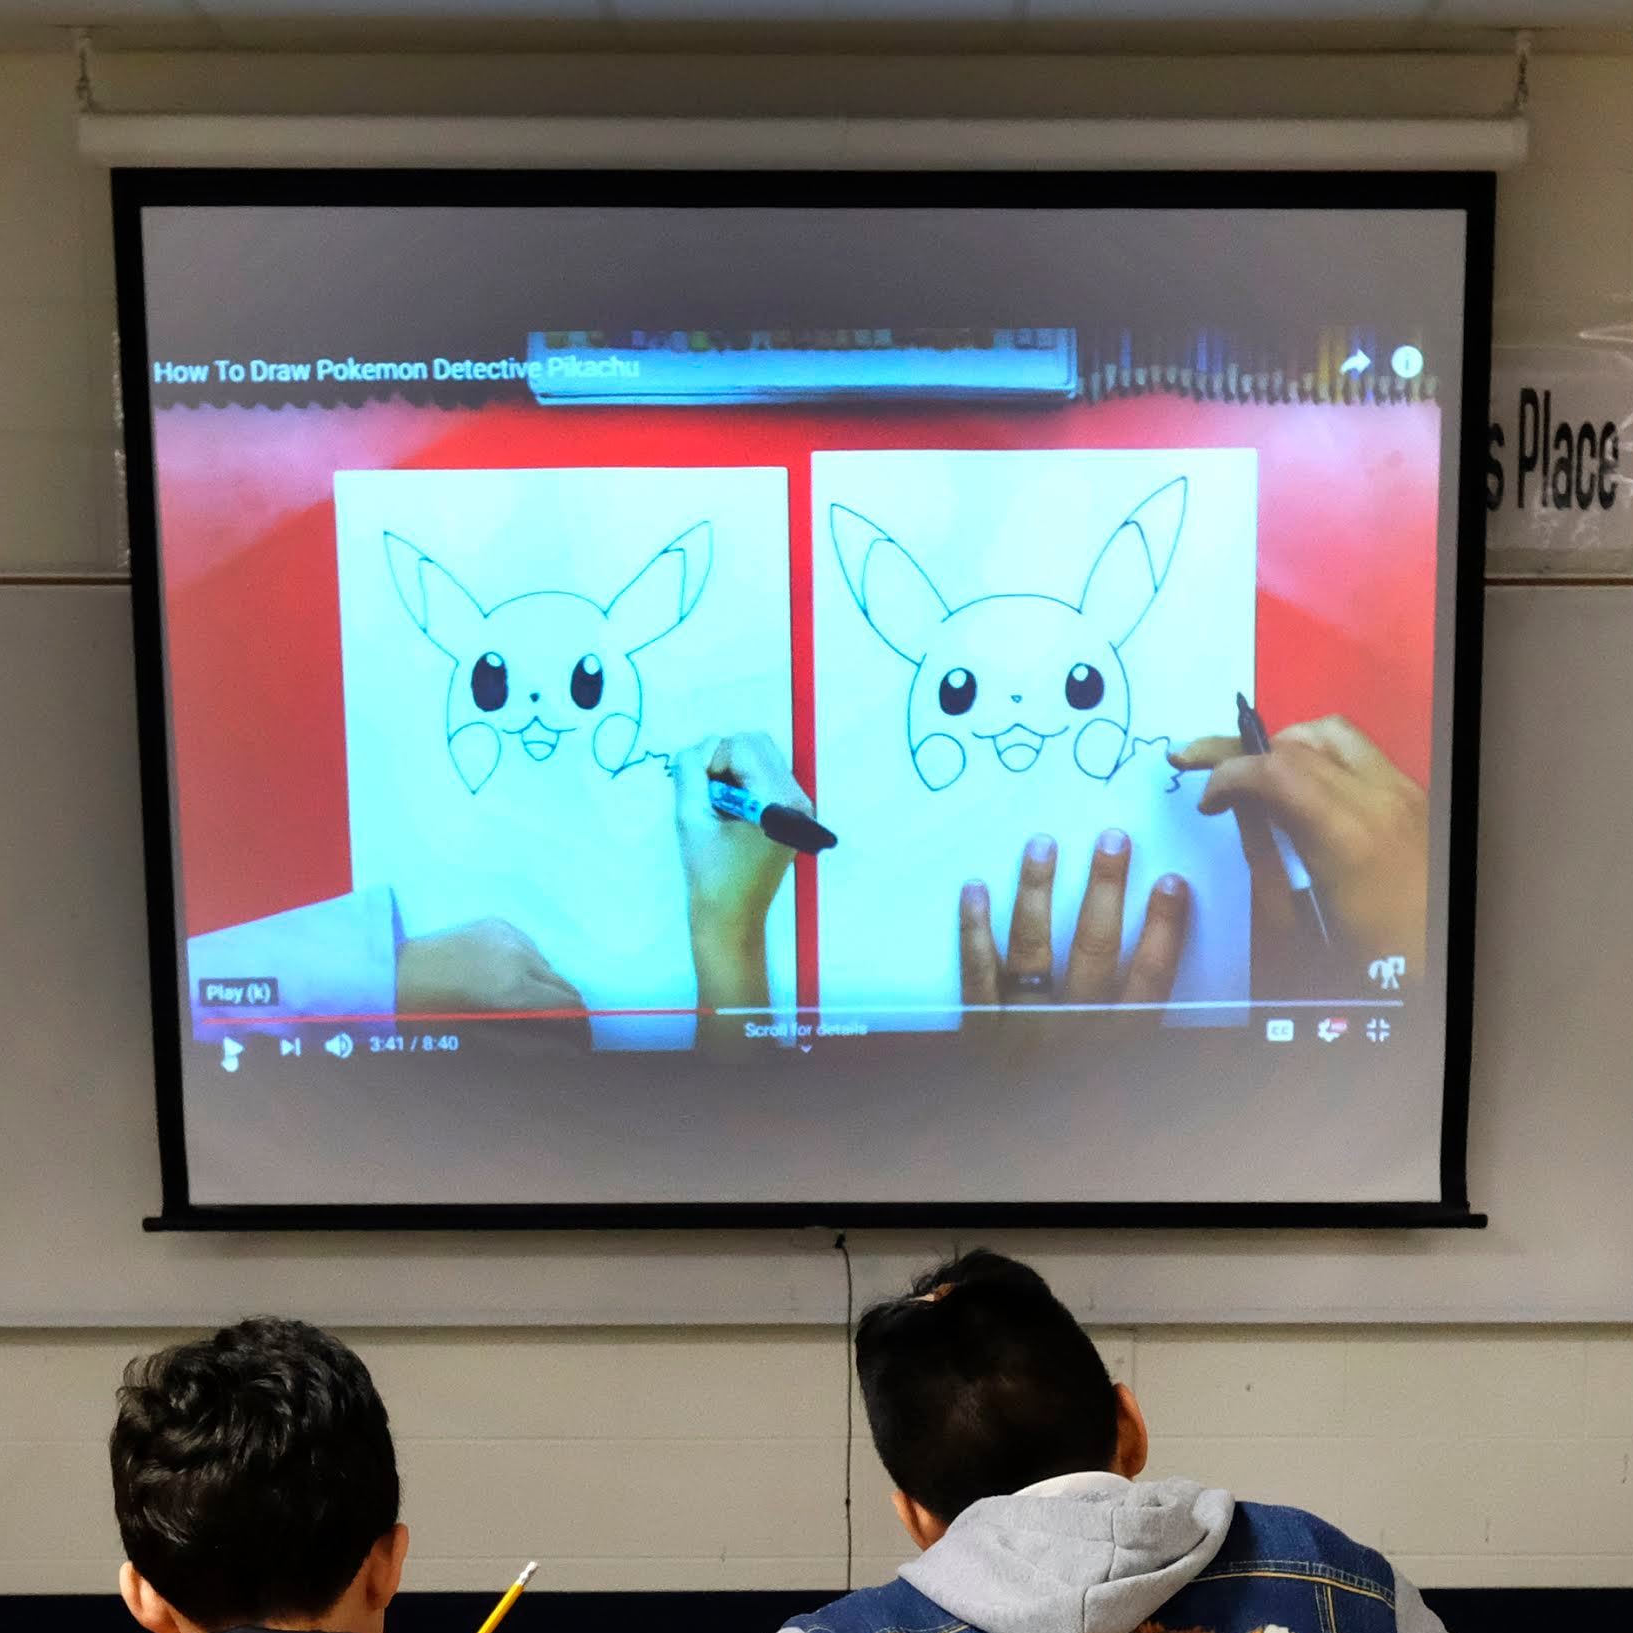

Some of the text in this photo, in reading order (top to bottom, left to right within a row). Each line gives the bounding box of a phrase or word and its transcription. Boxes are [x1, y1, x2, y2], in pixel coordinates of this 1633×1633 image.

[153, 354, 640, 383] How To Draw Pokemon Detective Pikachu
[1518, 386, 1619, 511] Place
[205, 982, 272, 1004] Play (k)
[744, 1021, 868, 1038] Scroll for details
[369, 1035, 405, 1052] 3:41
[422, 1035, 460, 1052] 8:40
